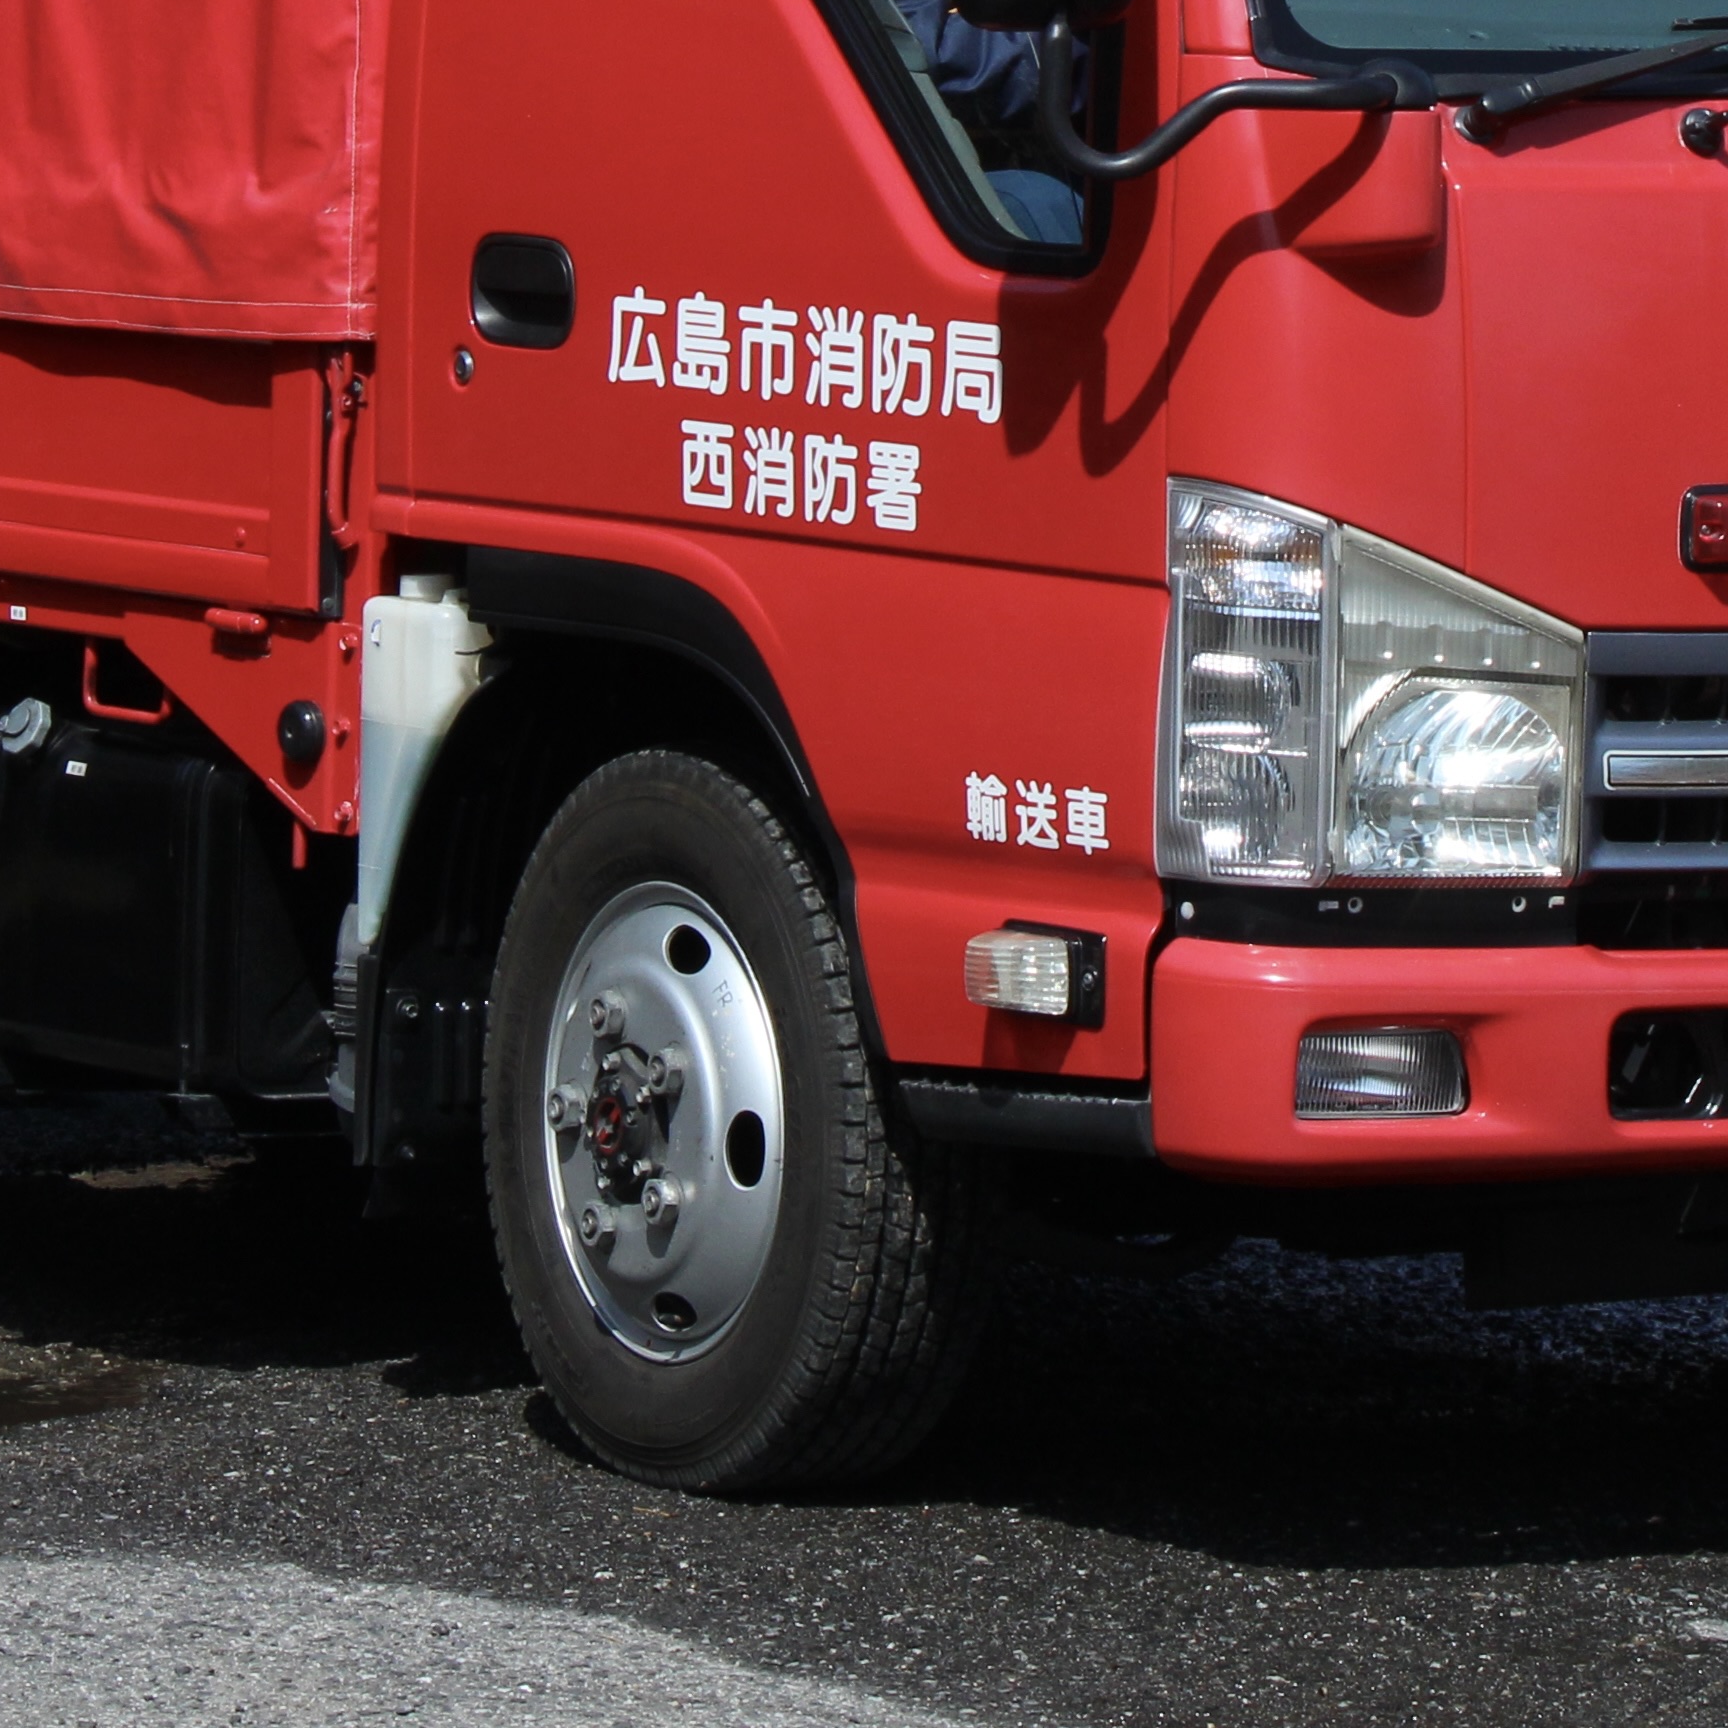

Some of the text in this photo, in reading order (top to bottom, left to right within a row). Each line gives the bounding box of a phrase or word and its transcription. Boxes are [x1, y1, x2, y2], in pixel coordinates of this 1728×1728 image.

[608, 285, 1003, 424] 広島市消防局
[681, 419, 922, 532] 西消防署
[965, 772, 1110, 855] 輸送車
